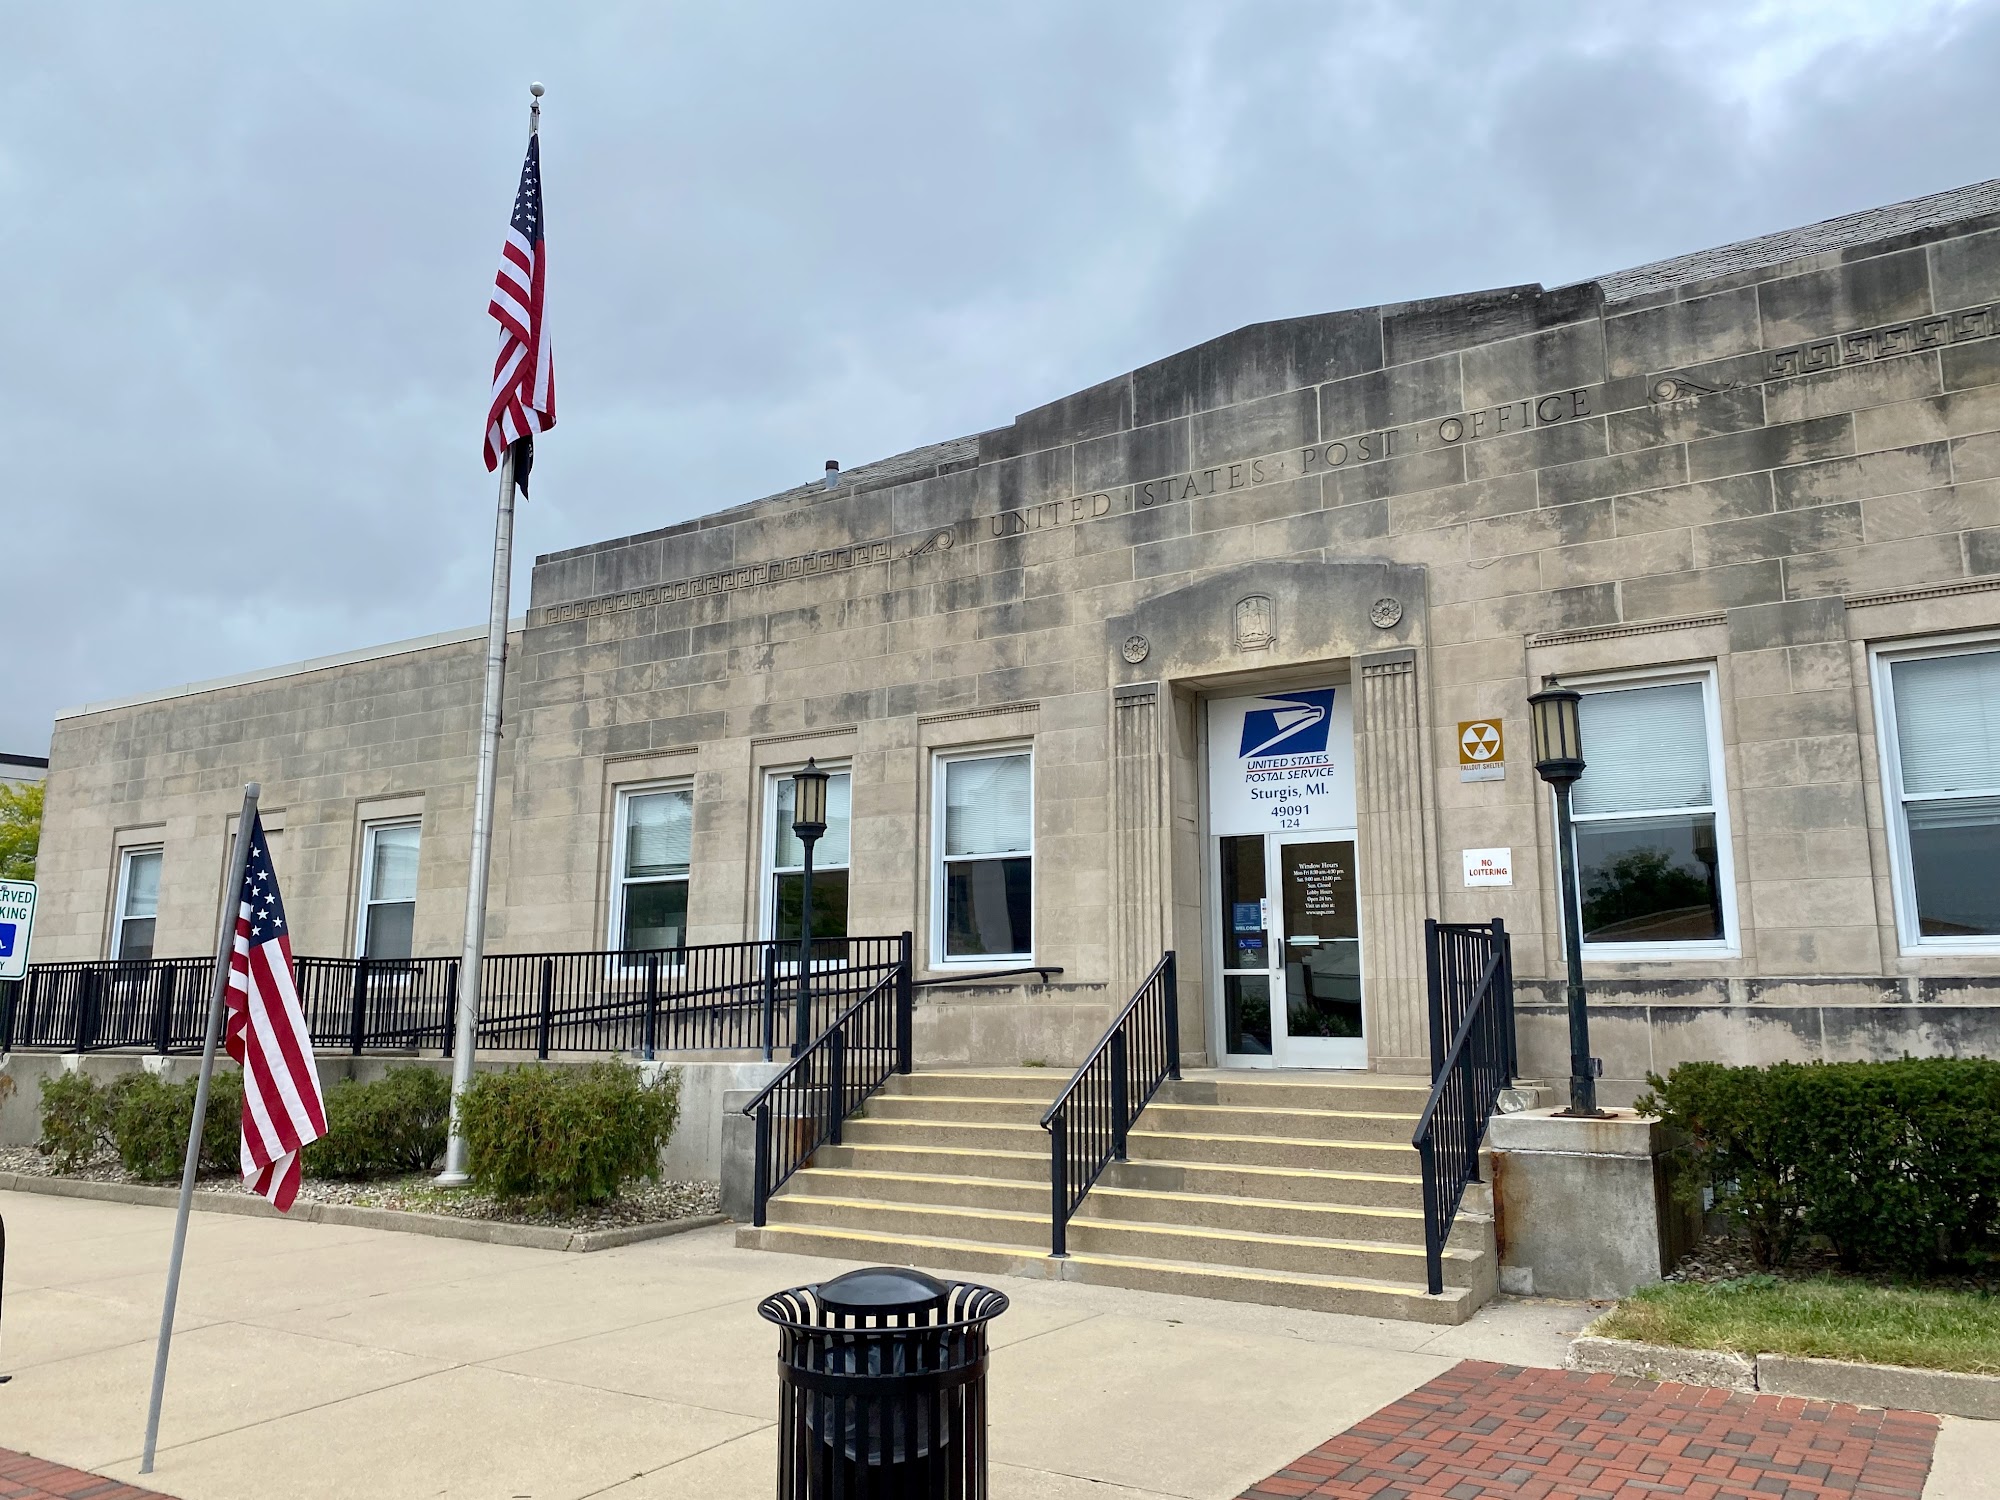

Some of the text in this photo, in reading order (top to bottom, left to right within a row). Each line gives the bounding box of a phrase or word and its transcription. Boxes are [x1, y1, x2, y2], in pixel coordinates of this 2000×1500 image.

[990, 390, 1591, 537] UNITED STATES POST OFFICE
[1247, 754, 1329, 770] UNITED STATES
[1482, 762, 1504, 770] SHELTER
[1246, 767, 1334, 783] POSTAL SERVICE
[1251, 782, 1329, 802] Sturgis, MI.
[1271, 804, 1309, 817] 49091
[1280, 818, 1300, 828] 124
[1321, 861, 1339, 869] Hours
[1481, 859, 1493, 867] NO
[1469, 868, 1508, 876] LOITERING
